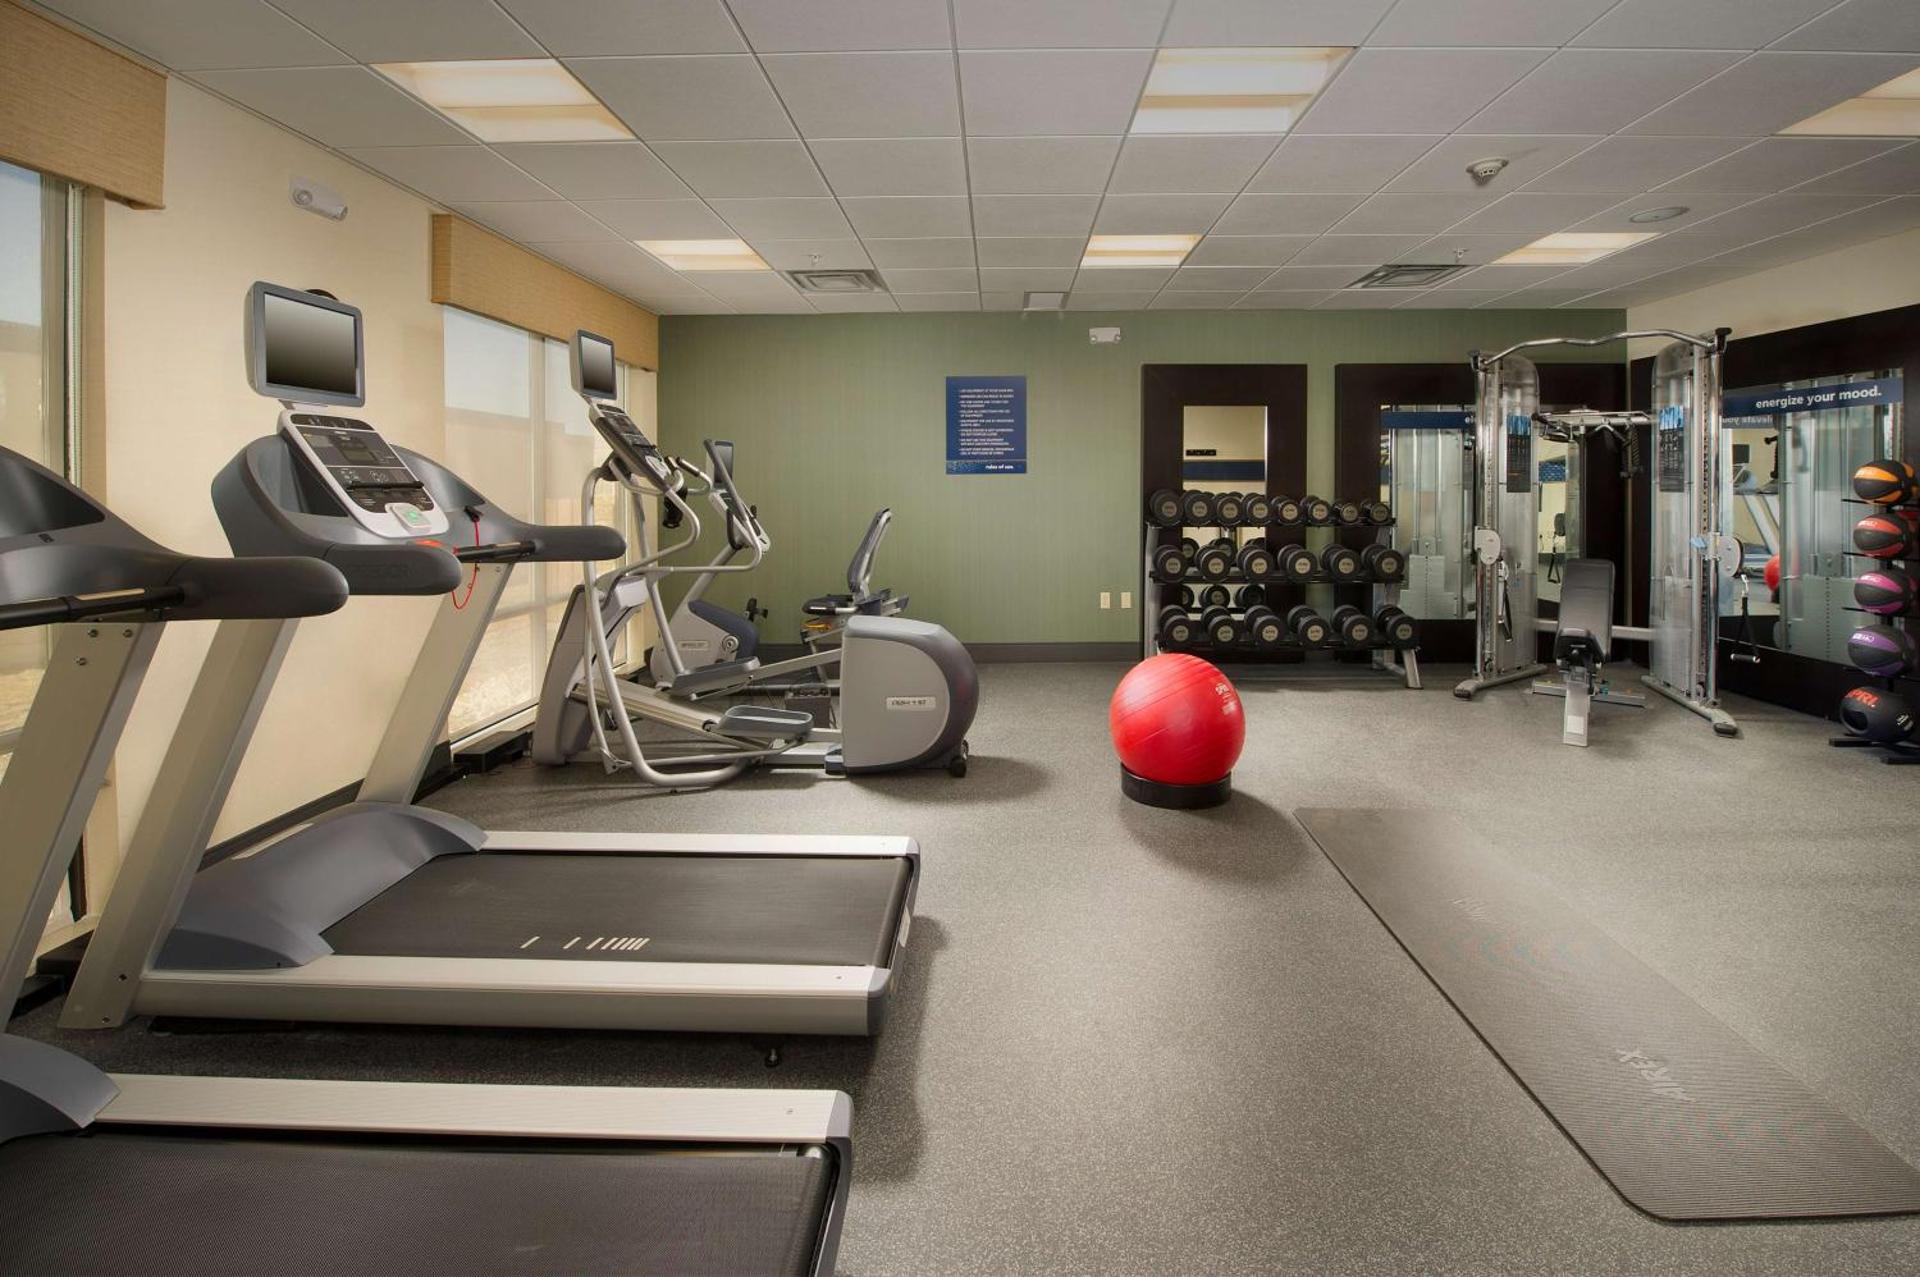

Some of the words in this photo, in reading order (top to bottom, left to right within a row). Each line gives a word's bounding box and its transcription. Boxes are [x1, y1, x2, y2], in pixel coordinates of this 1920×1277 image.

[1756, 395, 1804, 408] energize
[1806, 392, 1836, 406] your
[1839, 386, 1882, 399] mood.
